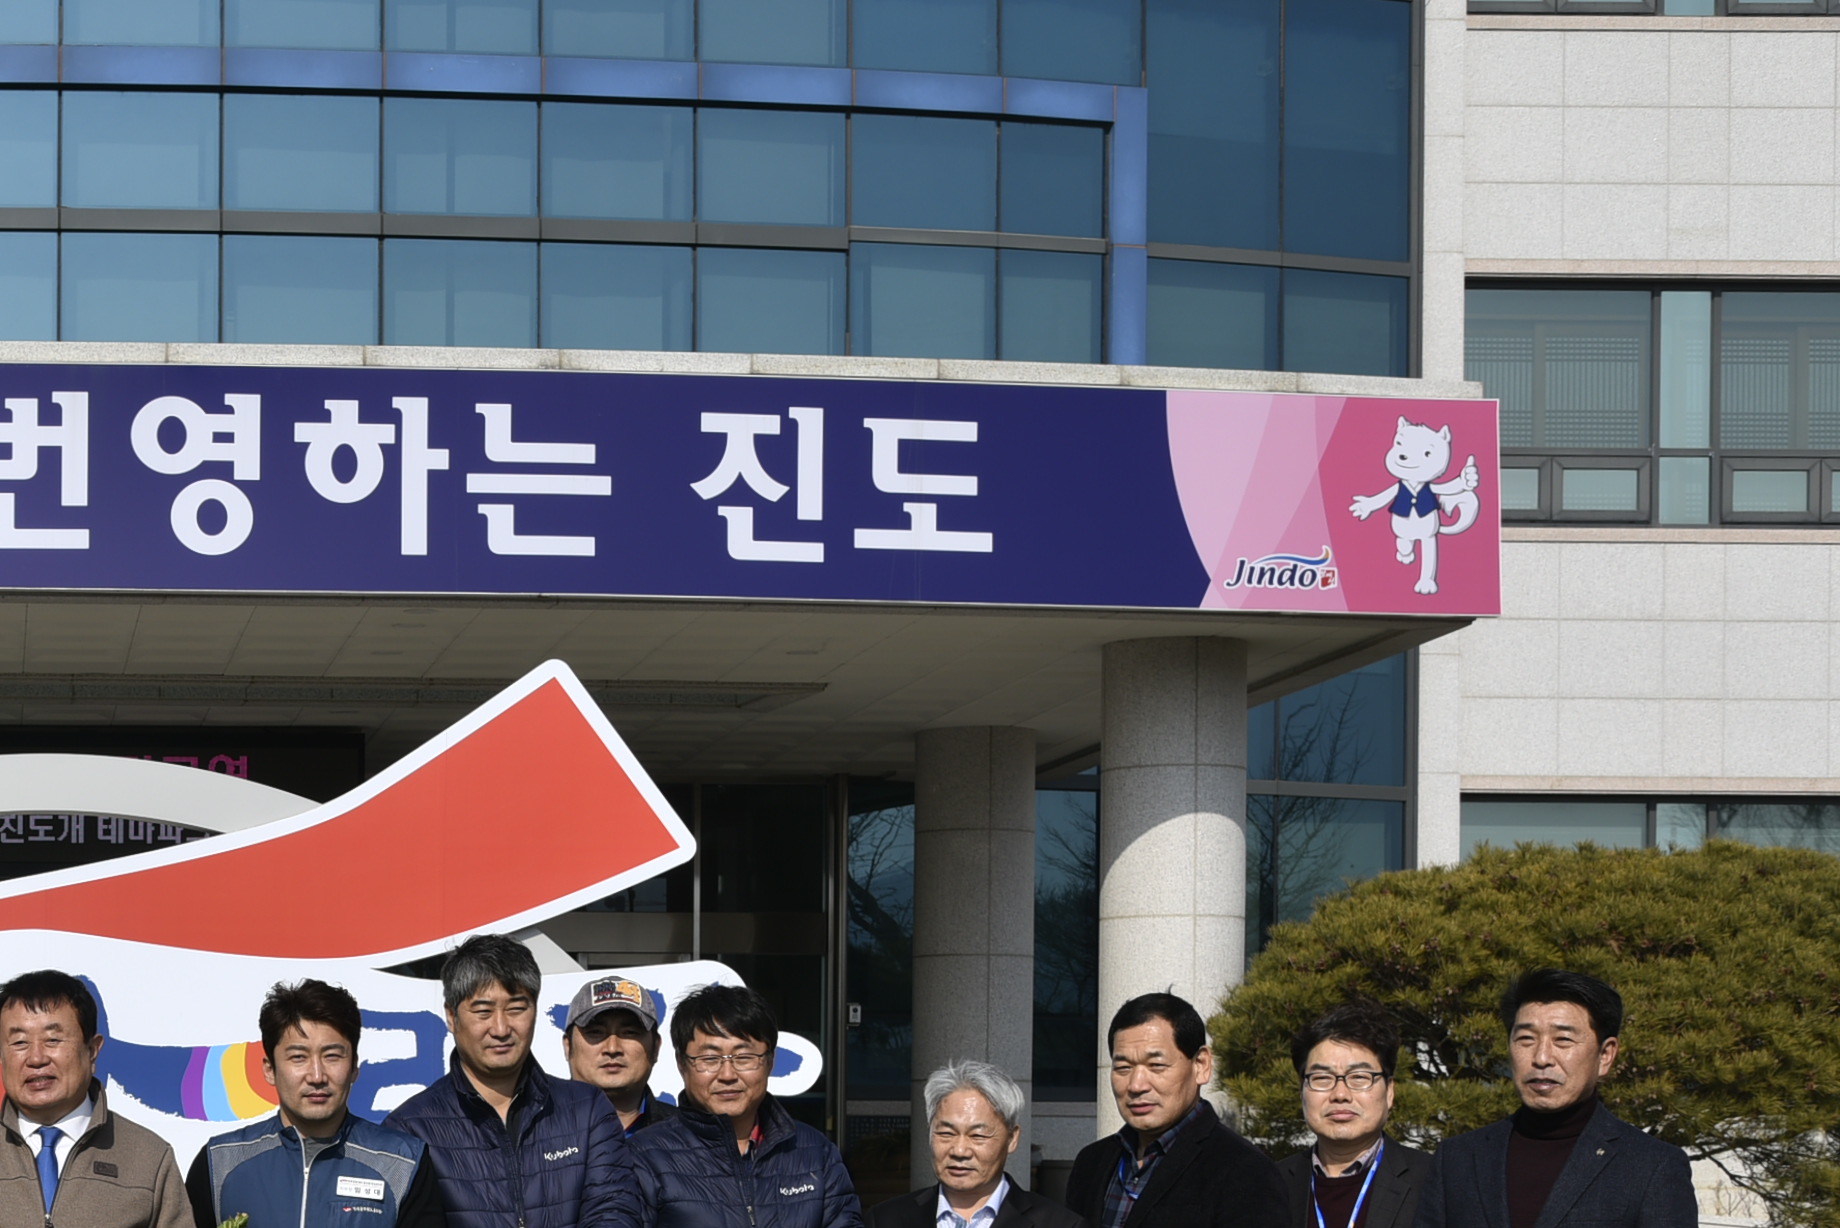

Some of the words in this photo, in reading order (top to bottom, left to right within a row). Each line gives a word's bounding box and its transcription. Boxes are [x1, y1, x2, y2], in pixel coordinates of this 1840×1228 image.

[690, 406, 993, 563] 진도
[1226, 559, 1317, 588] Jindo
[97, 816, 210, 844] 테마파
[544, 1146, 578, 1161] Kubota
[780, 1183, 814, 1196] Kubota
